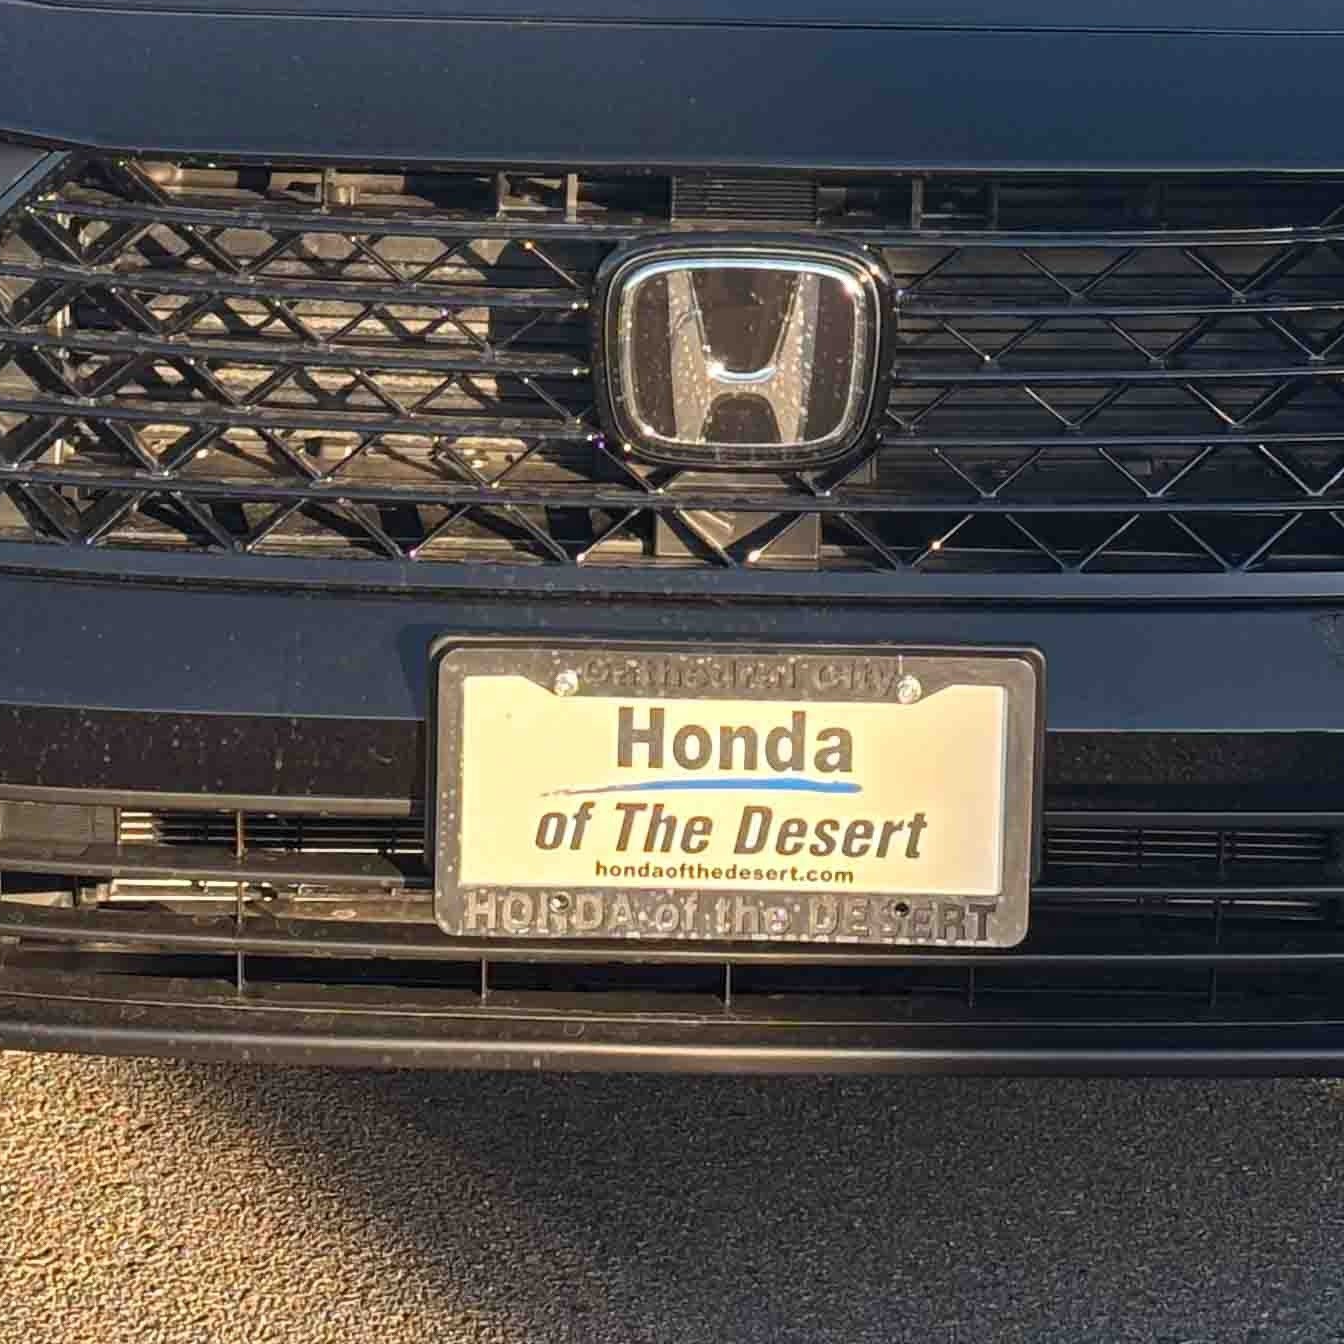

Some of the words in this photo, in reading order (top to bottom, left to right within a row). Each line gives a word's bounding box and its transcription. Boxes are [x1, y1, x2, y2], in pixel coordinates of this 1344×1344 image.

[814, 663, 897, 697] City
[616, 706, 854, 774] Honda
[535, 802, 594, 852] of
[615, 803, 714, 855] The
[734, 805, 928, 859] Desert
[595, 860, 855, 885] hondaofthedesert.com
[464, 889, 636, 934] HONDA
[809, 894, 997, 941] DESERT
